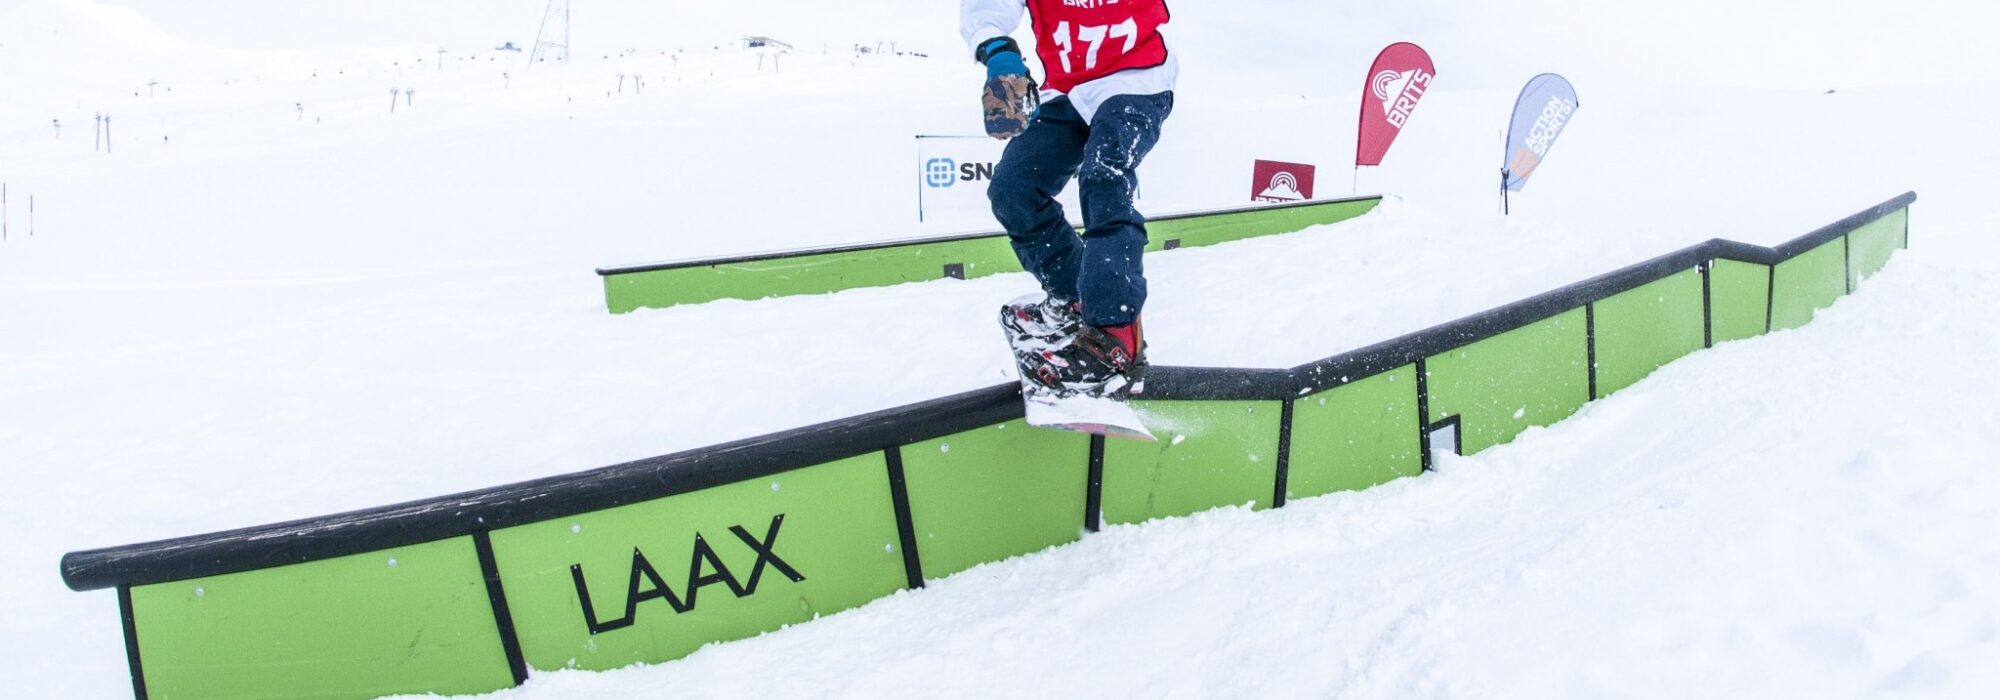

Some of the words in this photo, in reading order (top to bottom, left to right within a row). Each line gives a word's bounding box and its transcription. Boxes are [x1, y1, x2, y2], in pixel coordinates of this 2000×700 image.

[1052, 16, 1138, 74] 177
[1386, 68, 1432, 129] BRITS
[1524, 95, 1562, 152] ACTION
[959, 162, 993, 182] SN
[569, 513, 807, 636] LAAX
